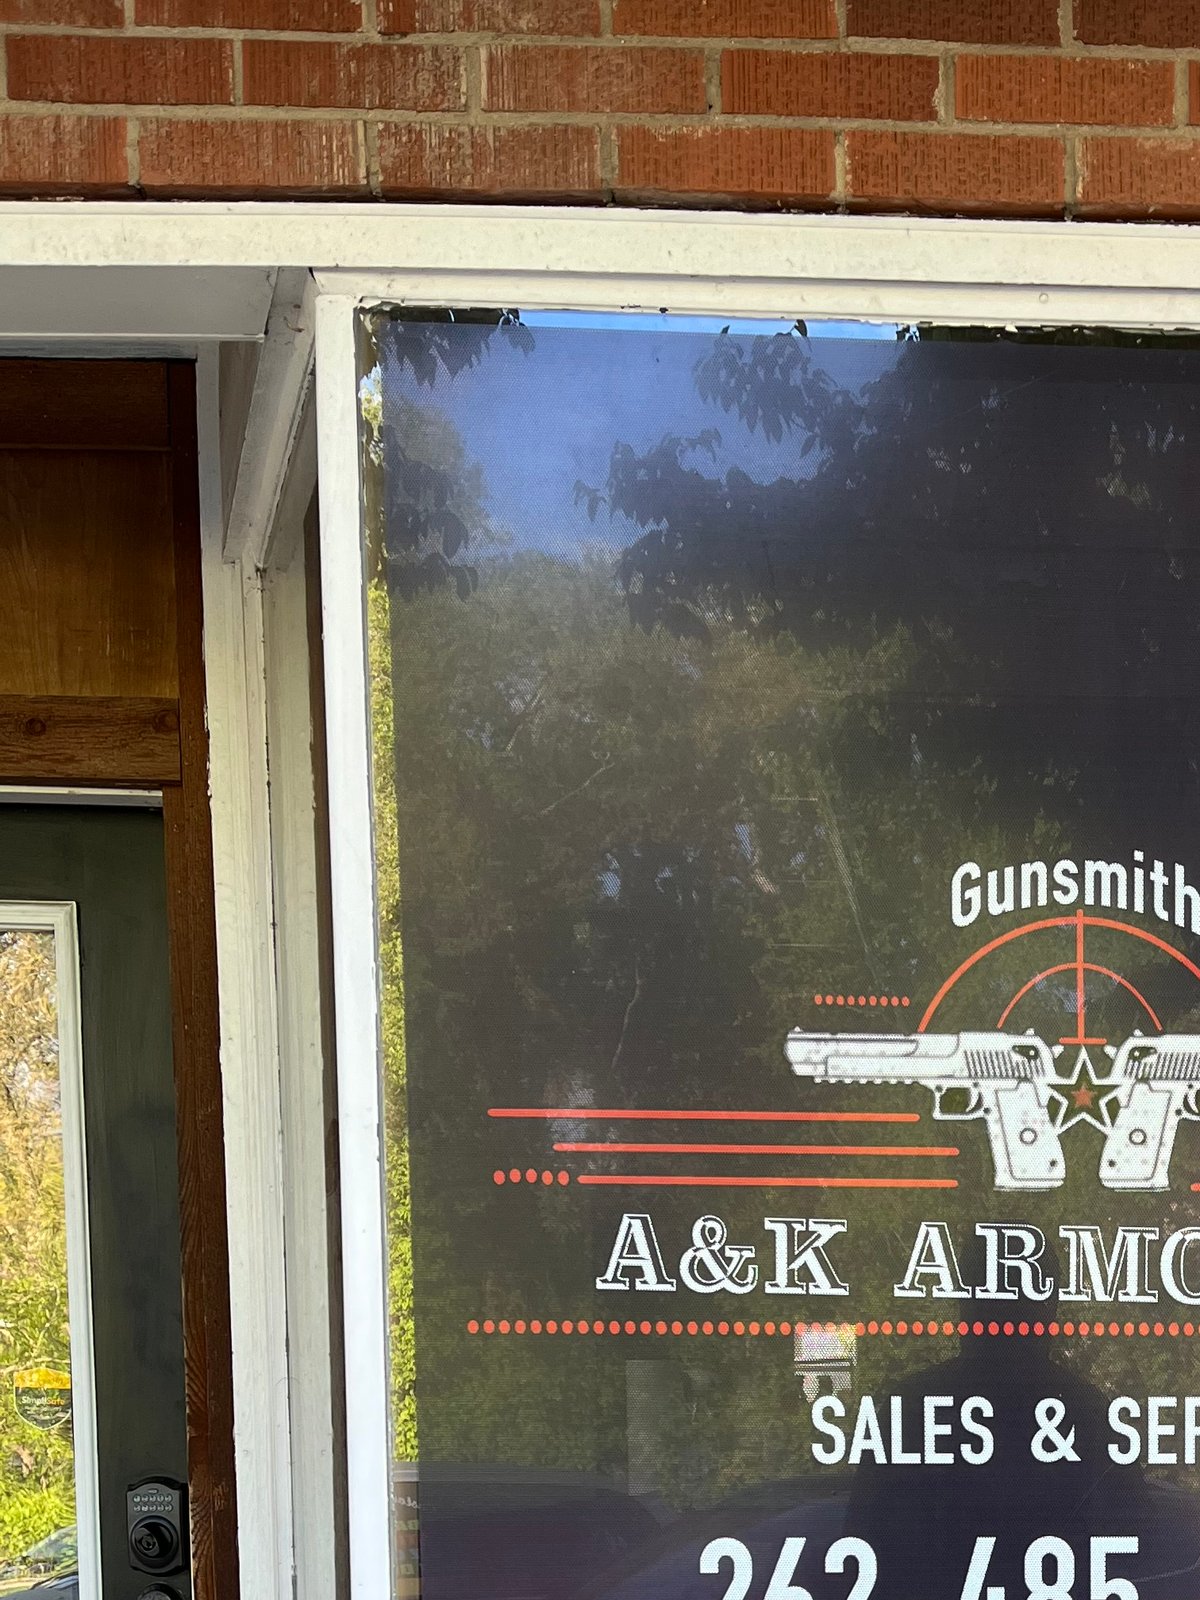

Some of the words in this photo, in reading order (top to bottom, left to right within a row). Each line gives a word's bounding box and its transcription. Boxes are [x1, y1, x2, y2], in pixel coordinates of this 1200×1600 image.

[596, 1214, 850, 1296] A&K
[811, 1396, 993, 1465] SALES
[1031, 1398, 1081, 1464] &
